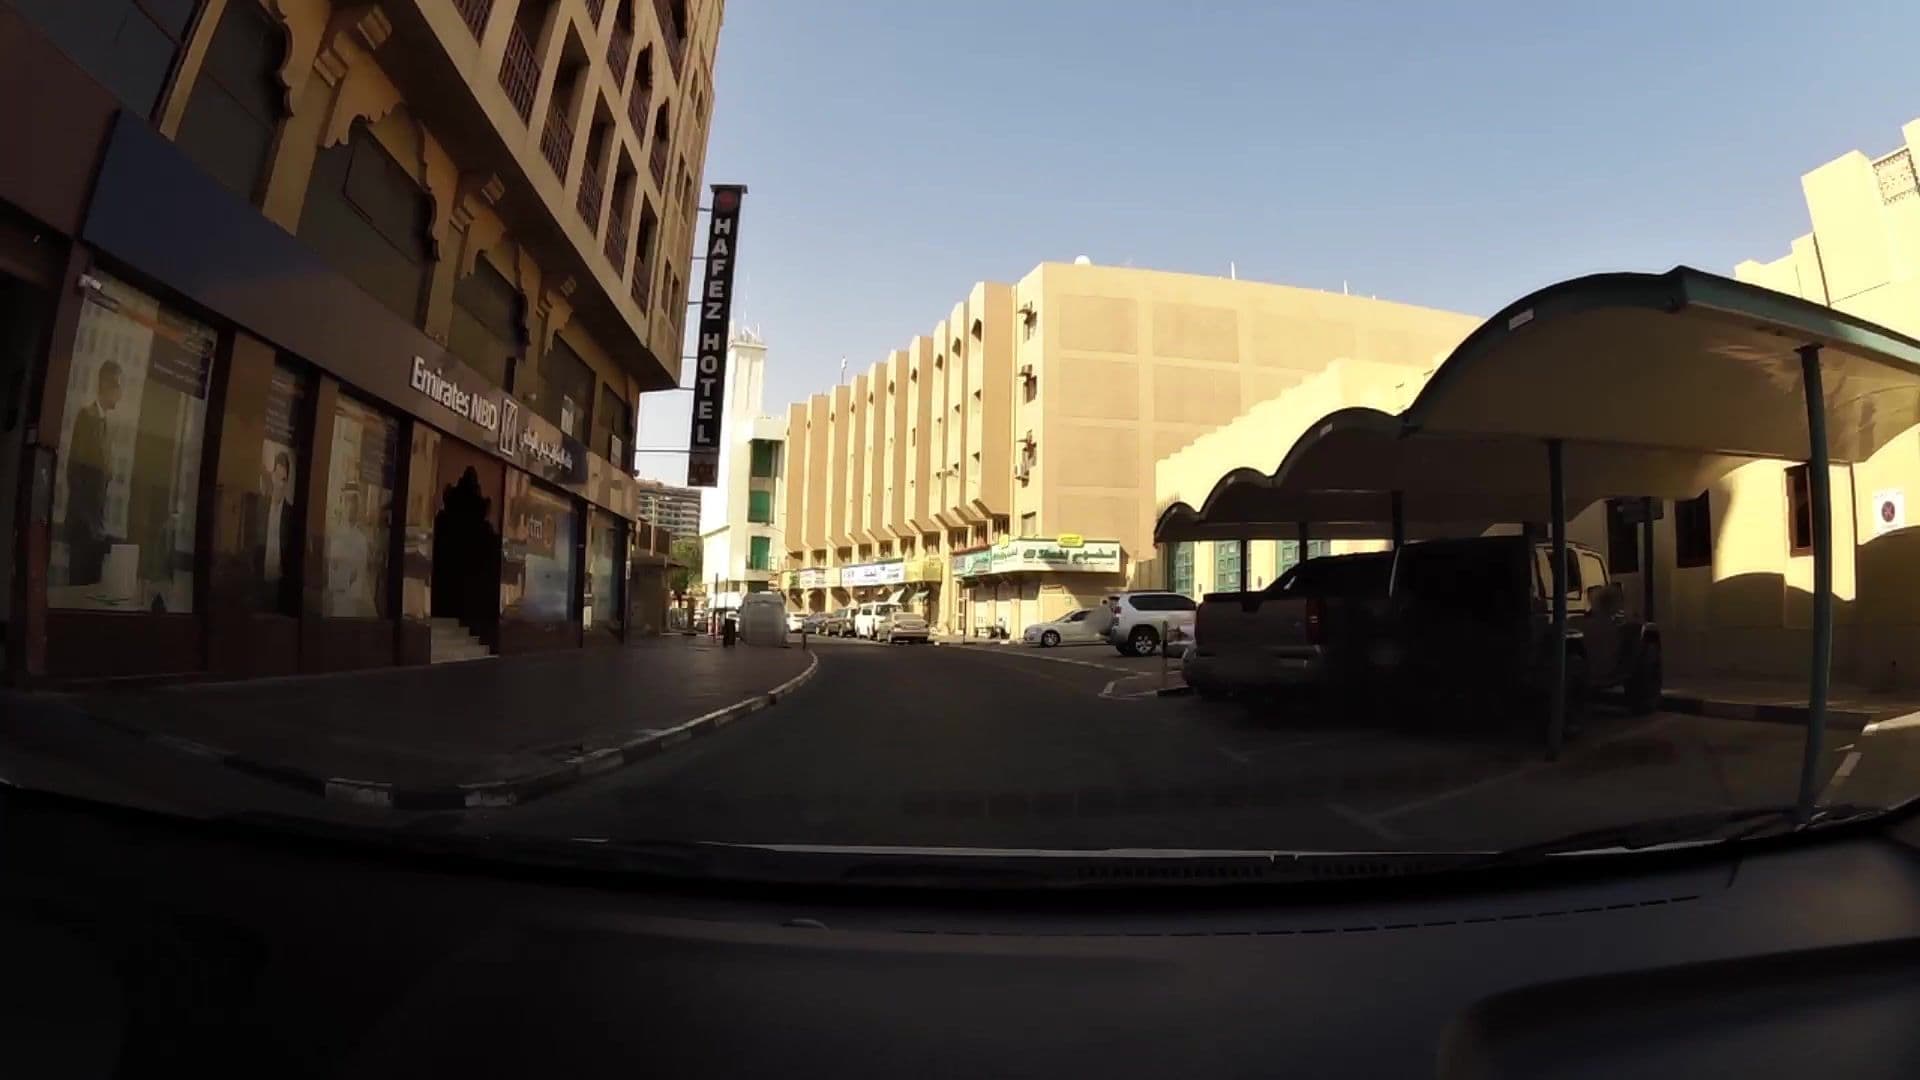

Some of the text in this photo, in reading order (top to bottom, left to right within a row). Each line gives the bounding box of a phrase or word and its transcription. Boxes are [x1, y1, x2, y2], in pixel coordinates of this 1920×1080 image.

[704, 217, 731, 320] HAFEZ
[411, 355, 498, 431] Emirates NBD
[697, 331, 720, 444] HOTEL
